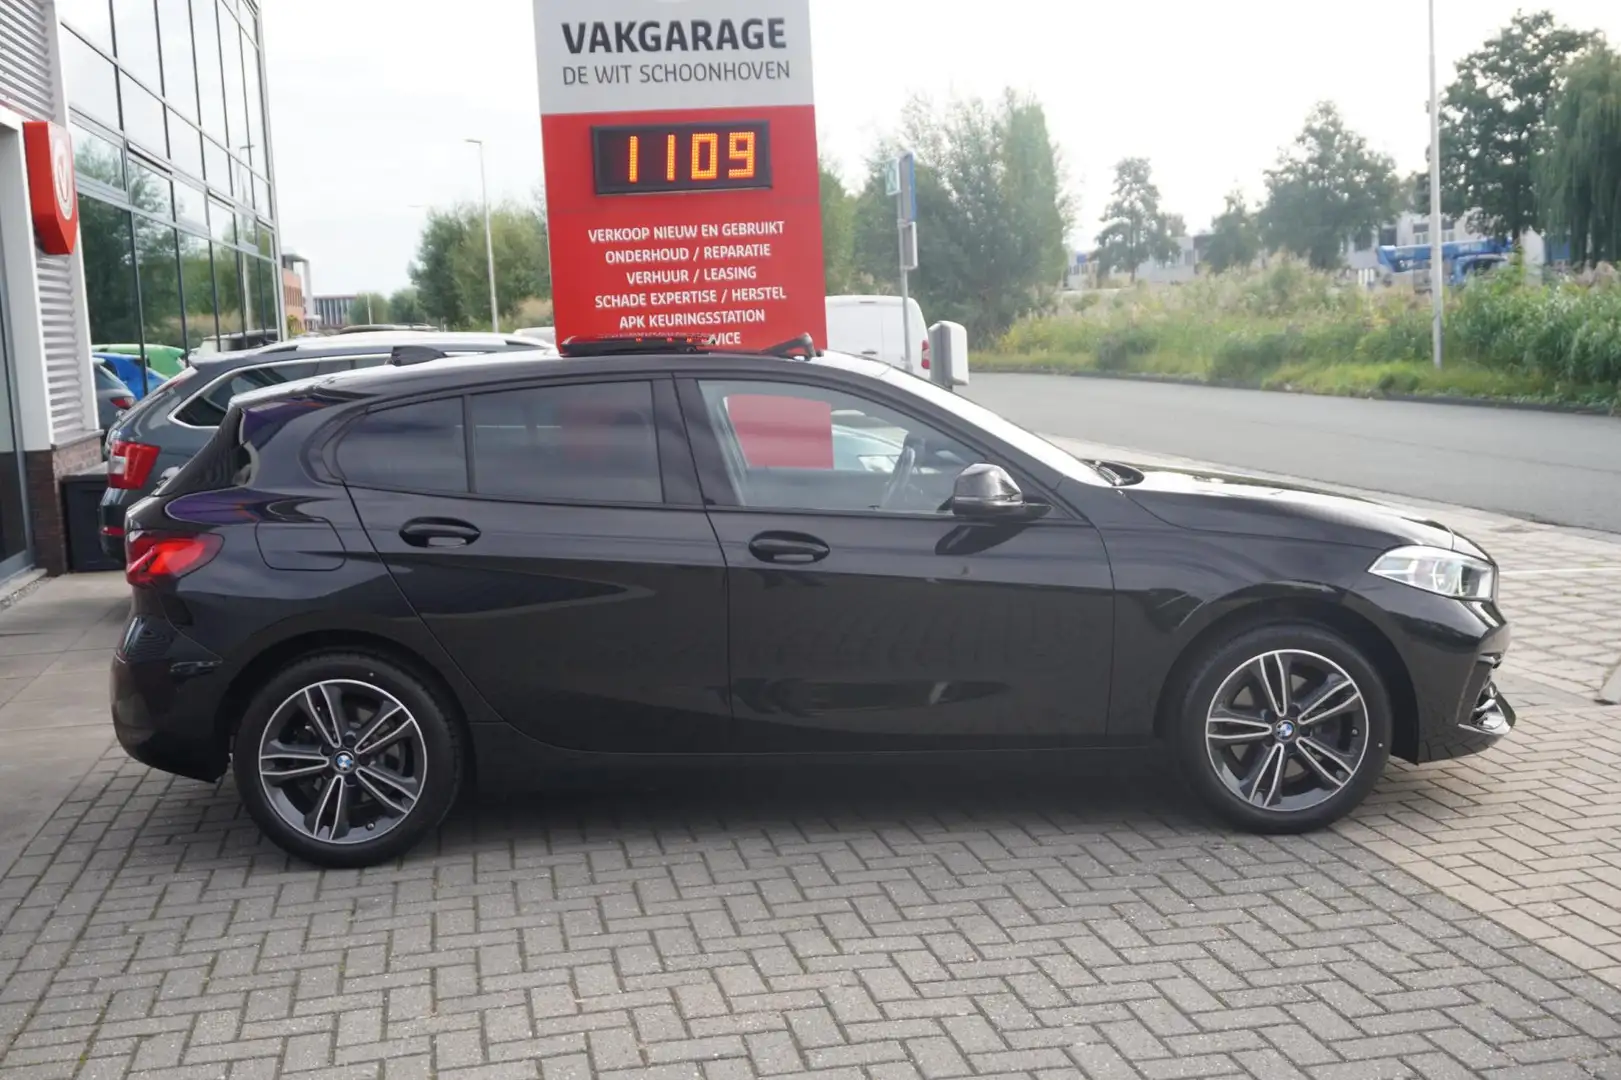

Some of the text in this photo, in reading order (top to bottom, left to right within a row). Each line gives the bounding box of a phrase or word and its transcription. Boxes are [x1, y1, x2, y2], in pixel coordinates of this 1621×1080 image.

[561, 17, 787, 54] VAKGARAGE
[562, 60, 790, 85] DE WIT SCHOONHOVEN
[588, 220, 785, 243] VERKOOP NIEUW EN GEBRUIKT
[605, 247, 689, 264] ONDERHOUD
[703, 243, 771, 260] REPARATIE
[626, 270, 689, 285] VERHUUR
[703, 265, 757, 281] LEASING
[595, 292, 646, 308] SCHADE
[650, 289, 717, 305] EXPERTISE
[731, 286, 787, 301] HERSTEL
[619, 308, 765, 329] APK KEURINGSSTATION
